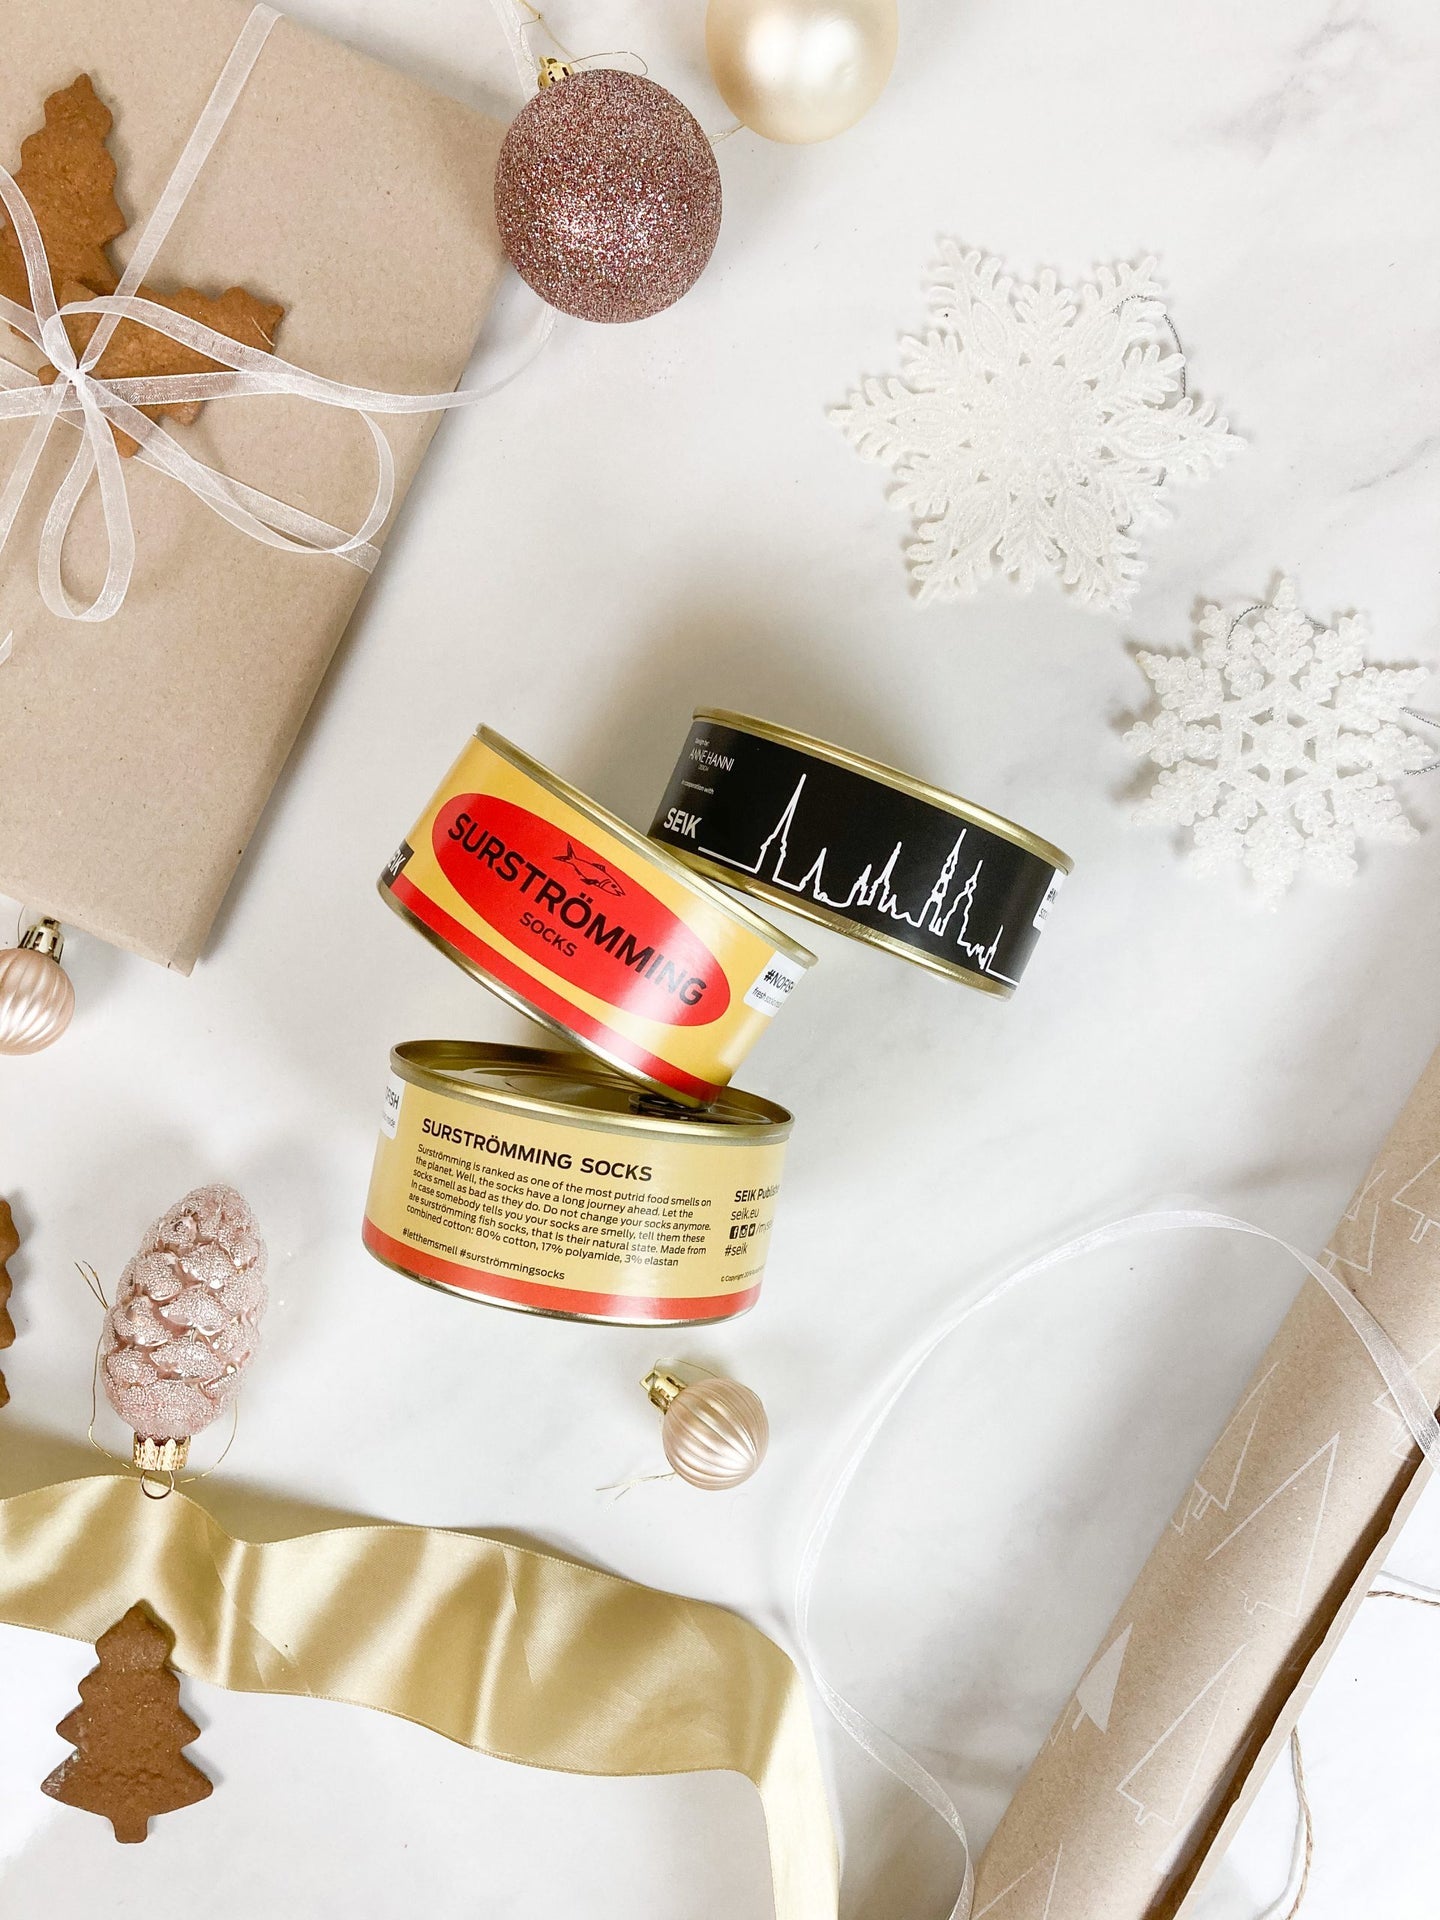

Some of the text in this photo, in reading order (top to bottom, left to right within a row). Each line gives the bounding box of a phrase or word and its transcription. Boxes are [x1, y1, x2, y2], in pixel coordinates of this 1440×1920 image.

[689, 748, 707, 763] ANNE
[706, 751, 734, 771] HANNI
[663, 808, 702, 838] SEIK
[448, 812, 707, 1006] SURSTRÖMMING
[519, 911, 578, 958] SOCKS
[418, 1144, 472, 1170] Surströmming
[472, 1161, 480, 1172] is
[482, 1166, 515, 1180] ranked
[516, 1174, 529, 1184] as
[530, 1178, 550, 1188] one
[552, 1180, 564, 1190] of
[566, 1182, 583, 1194] the
[585, 1186, 612, 1198] most
[614, 1192, 645, 1203] putrid
[647, 1194, 669, 1206] food
[670, 1198, 700, 1206] smells
[422, 1118, 572, 1170] SURSTRÖMMING
[580, 1158, 652, 1182] SOCKS
[410, 1180, 705, 1243] In case somebody tells you your socks are smelly, tell them these
[413, 1168, 712, 1232] socks smell as bad as they do. Do not change your socks anymore.
[416, 1156, 694, 1218] the planet. Well, the socks have a long journey ahead. Let the
[730, 1208, 760, 1220] seik.eu
[734, 1188, 758, 1202] SEIK
[402, 1228, 565, 1280] #letthemsmell #surströmmingsocks
[406, 1204, 678, 1266] combined cotton: 80% cotton, 17% polyamide, 3% elastan
[408, 1192, 707, 1255] are surströmming fish socks, that is their natural state. Made from
[724, 1242, 748, 1256] #seik
